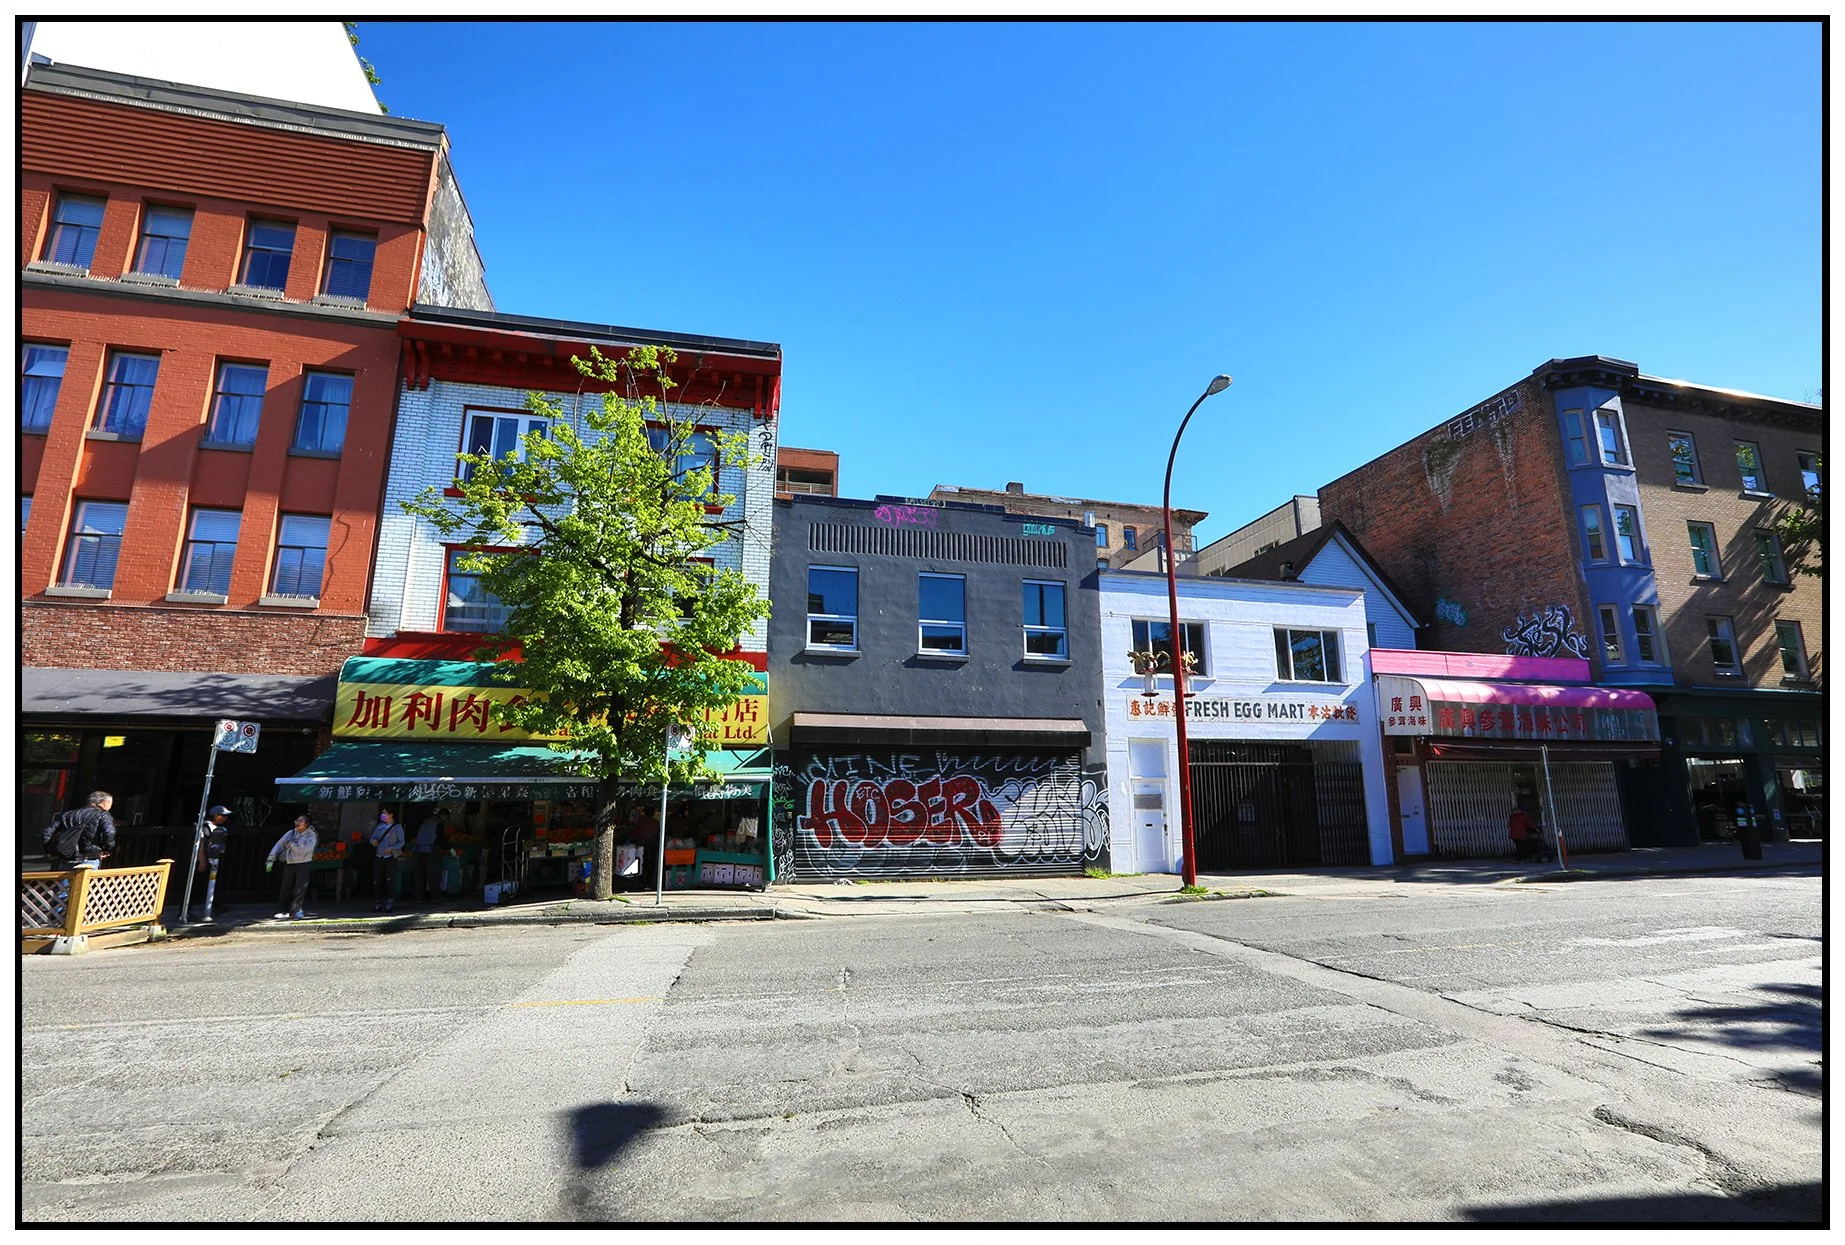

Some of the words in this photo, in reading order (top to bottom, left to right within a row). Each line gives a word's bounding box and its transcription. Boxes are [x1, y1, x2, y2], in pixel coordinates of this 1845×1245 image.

[1185, 700, 1229, 718] FRESH
[1234, 702, 1263, 719] EGG
[1267, 702, 1305, 719] MART
[1391, 695, 1422, 713] 廣興
[724, 725, 757, 739] Ltd.
[855, 783, 881, 802] ETC
[801, 775, 1001, 849] HOSER
